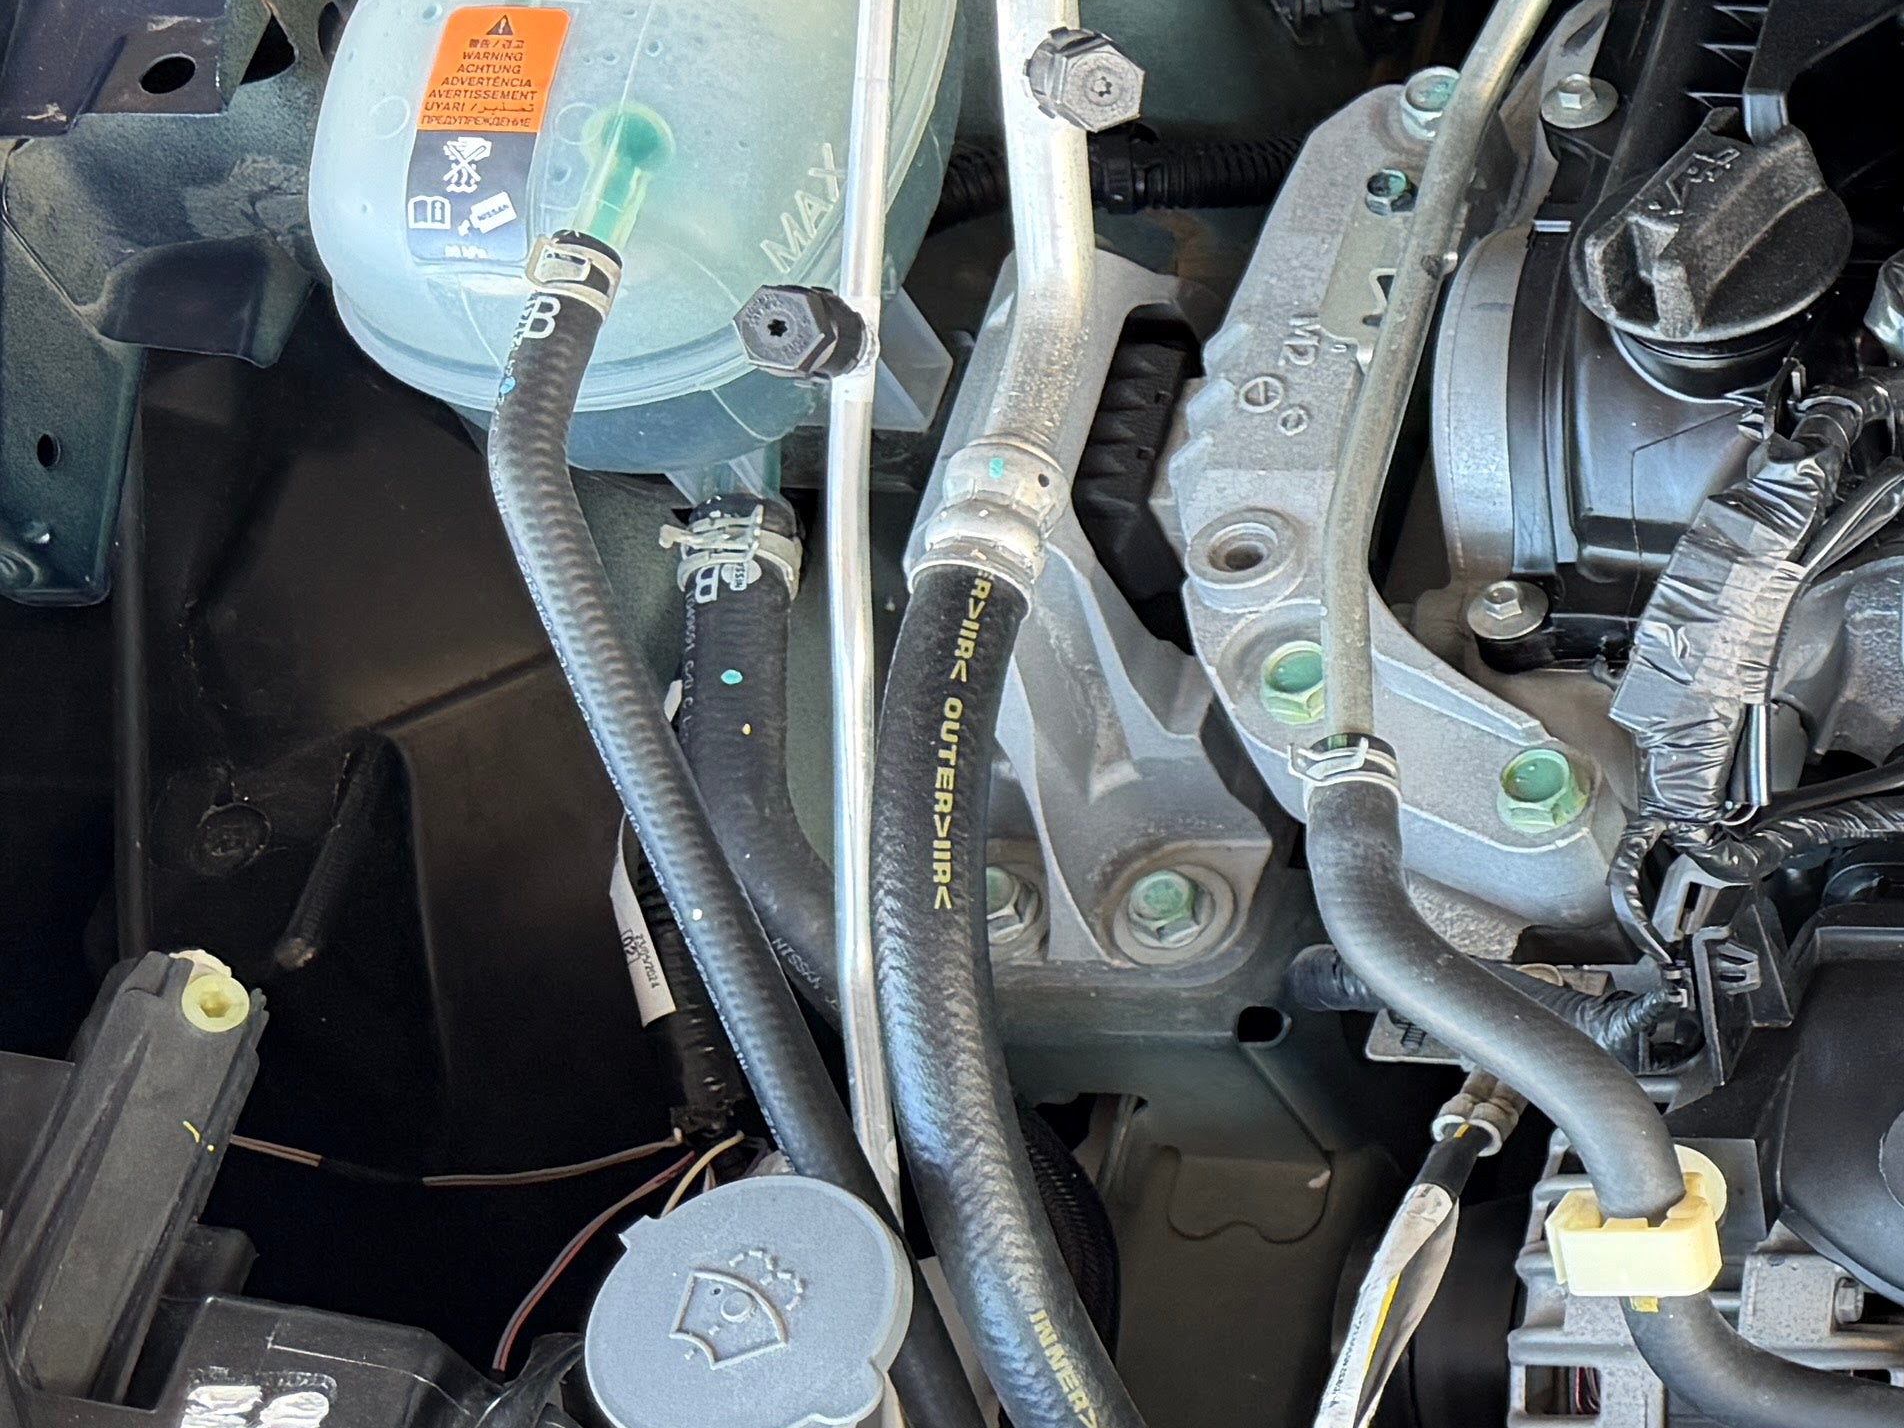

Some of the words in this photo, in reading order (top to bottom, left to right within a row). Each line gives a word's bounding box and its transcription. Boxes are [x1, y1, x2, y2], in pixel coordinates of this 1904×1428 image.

[462, 51, 523, 62] WARNING
[456, 63, 521, 74] ACHTUNG
[428, 89, 538, 101] AVERTISSEMENT
[760, 142, 846, 273] MAX
[523, 295, 562, 340] B
